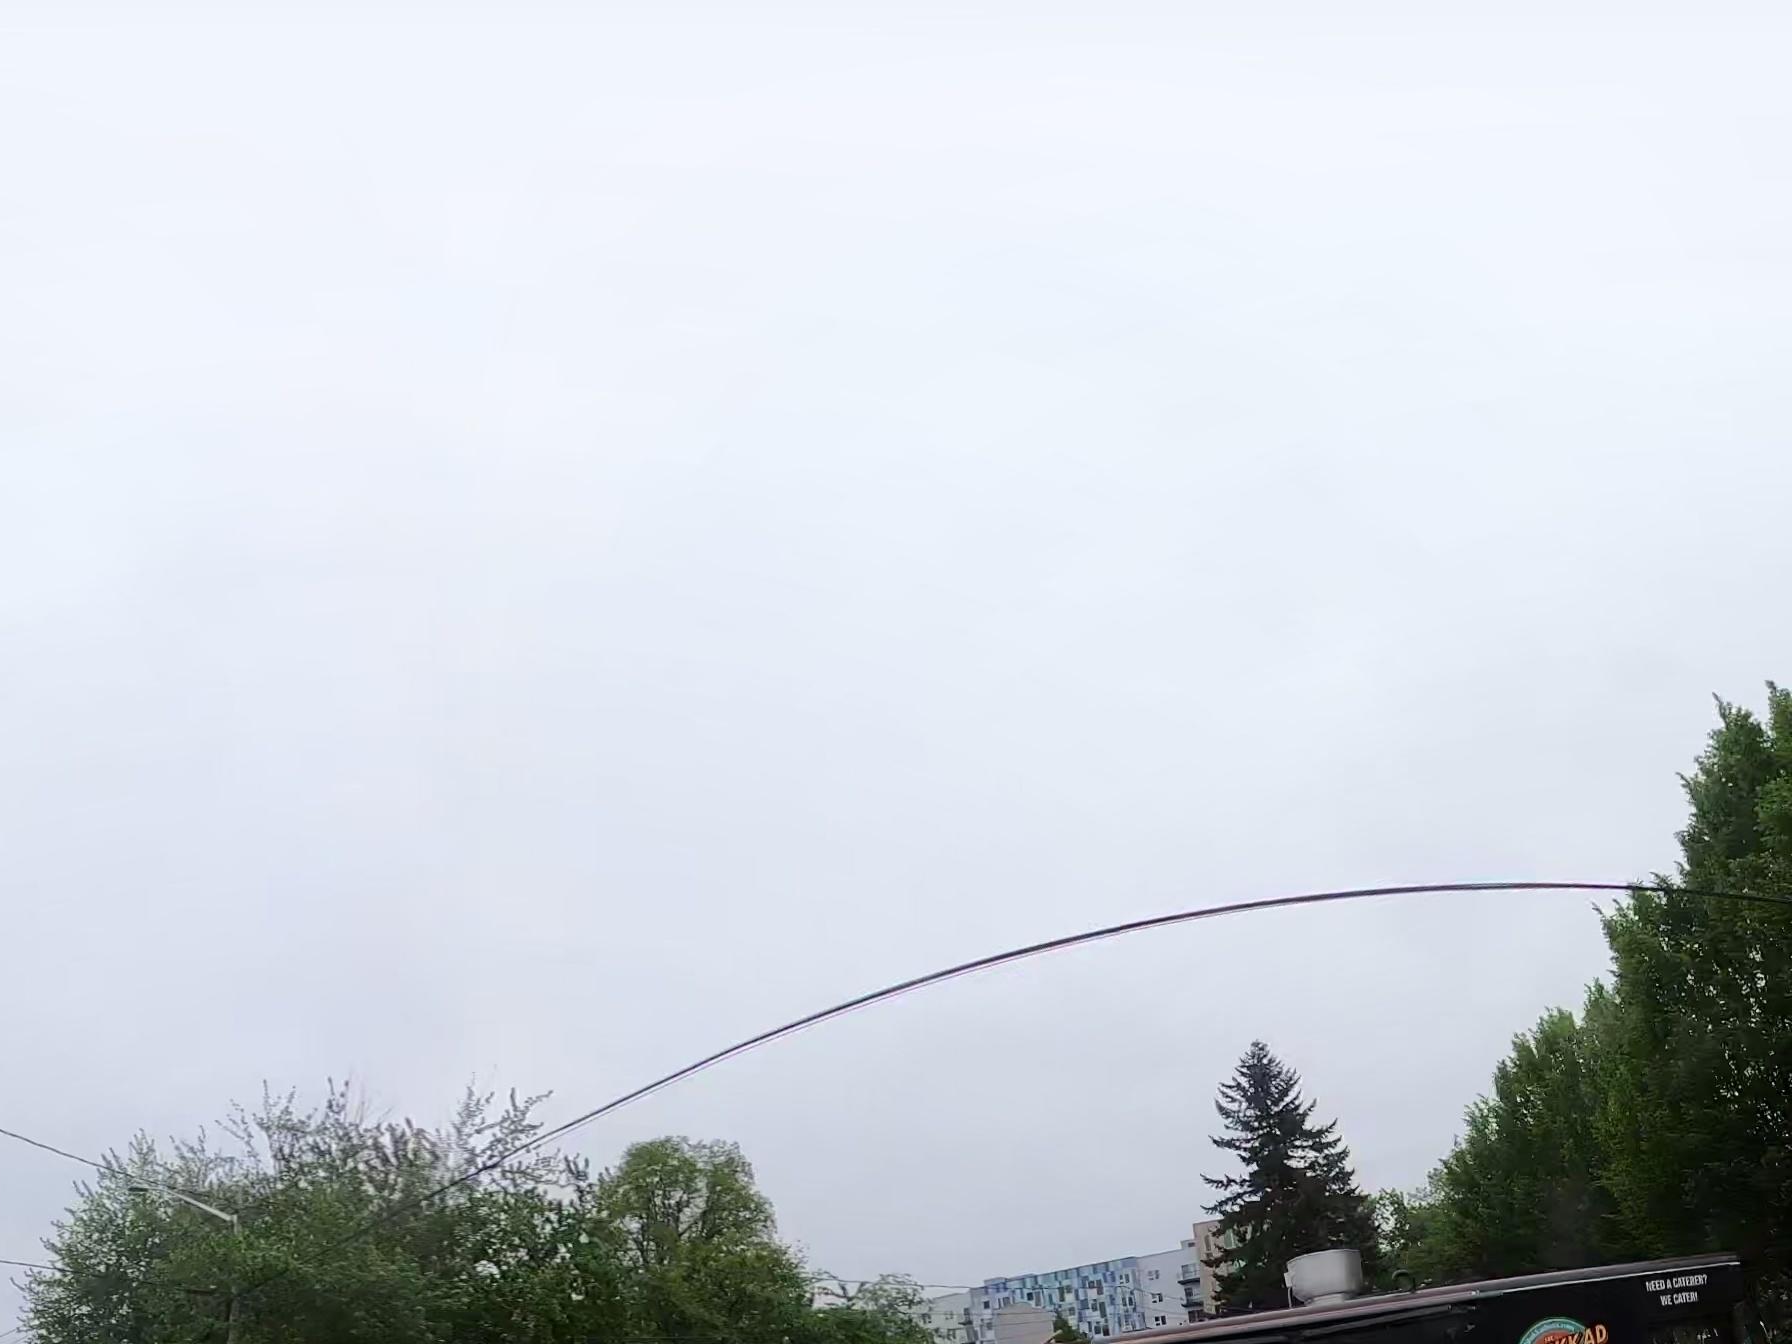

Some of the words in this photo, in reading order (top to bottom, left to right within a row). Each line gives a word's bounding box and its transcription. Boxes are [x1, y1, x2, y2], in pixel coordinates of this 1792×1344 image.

[1646, 1280, 1665, 1291] NEED
[1667, 1279, 1672, 1289] A
[1673, 1274, 1707, 1288] CATERER?
[1660, 1295, 1672, 1306] WE
[1674, 1291, 1697, 1304] CATER!
